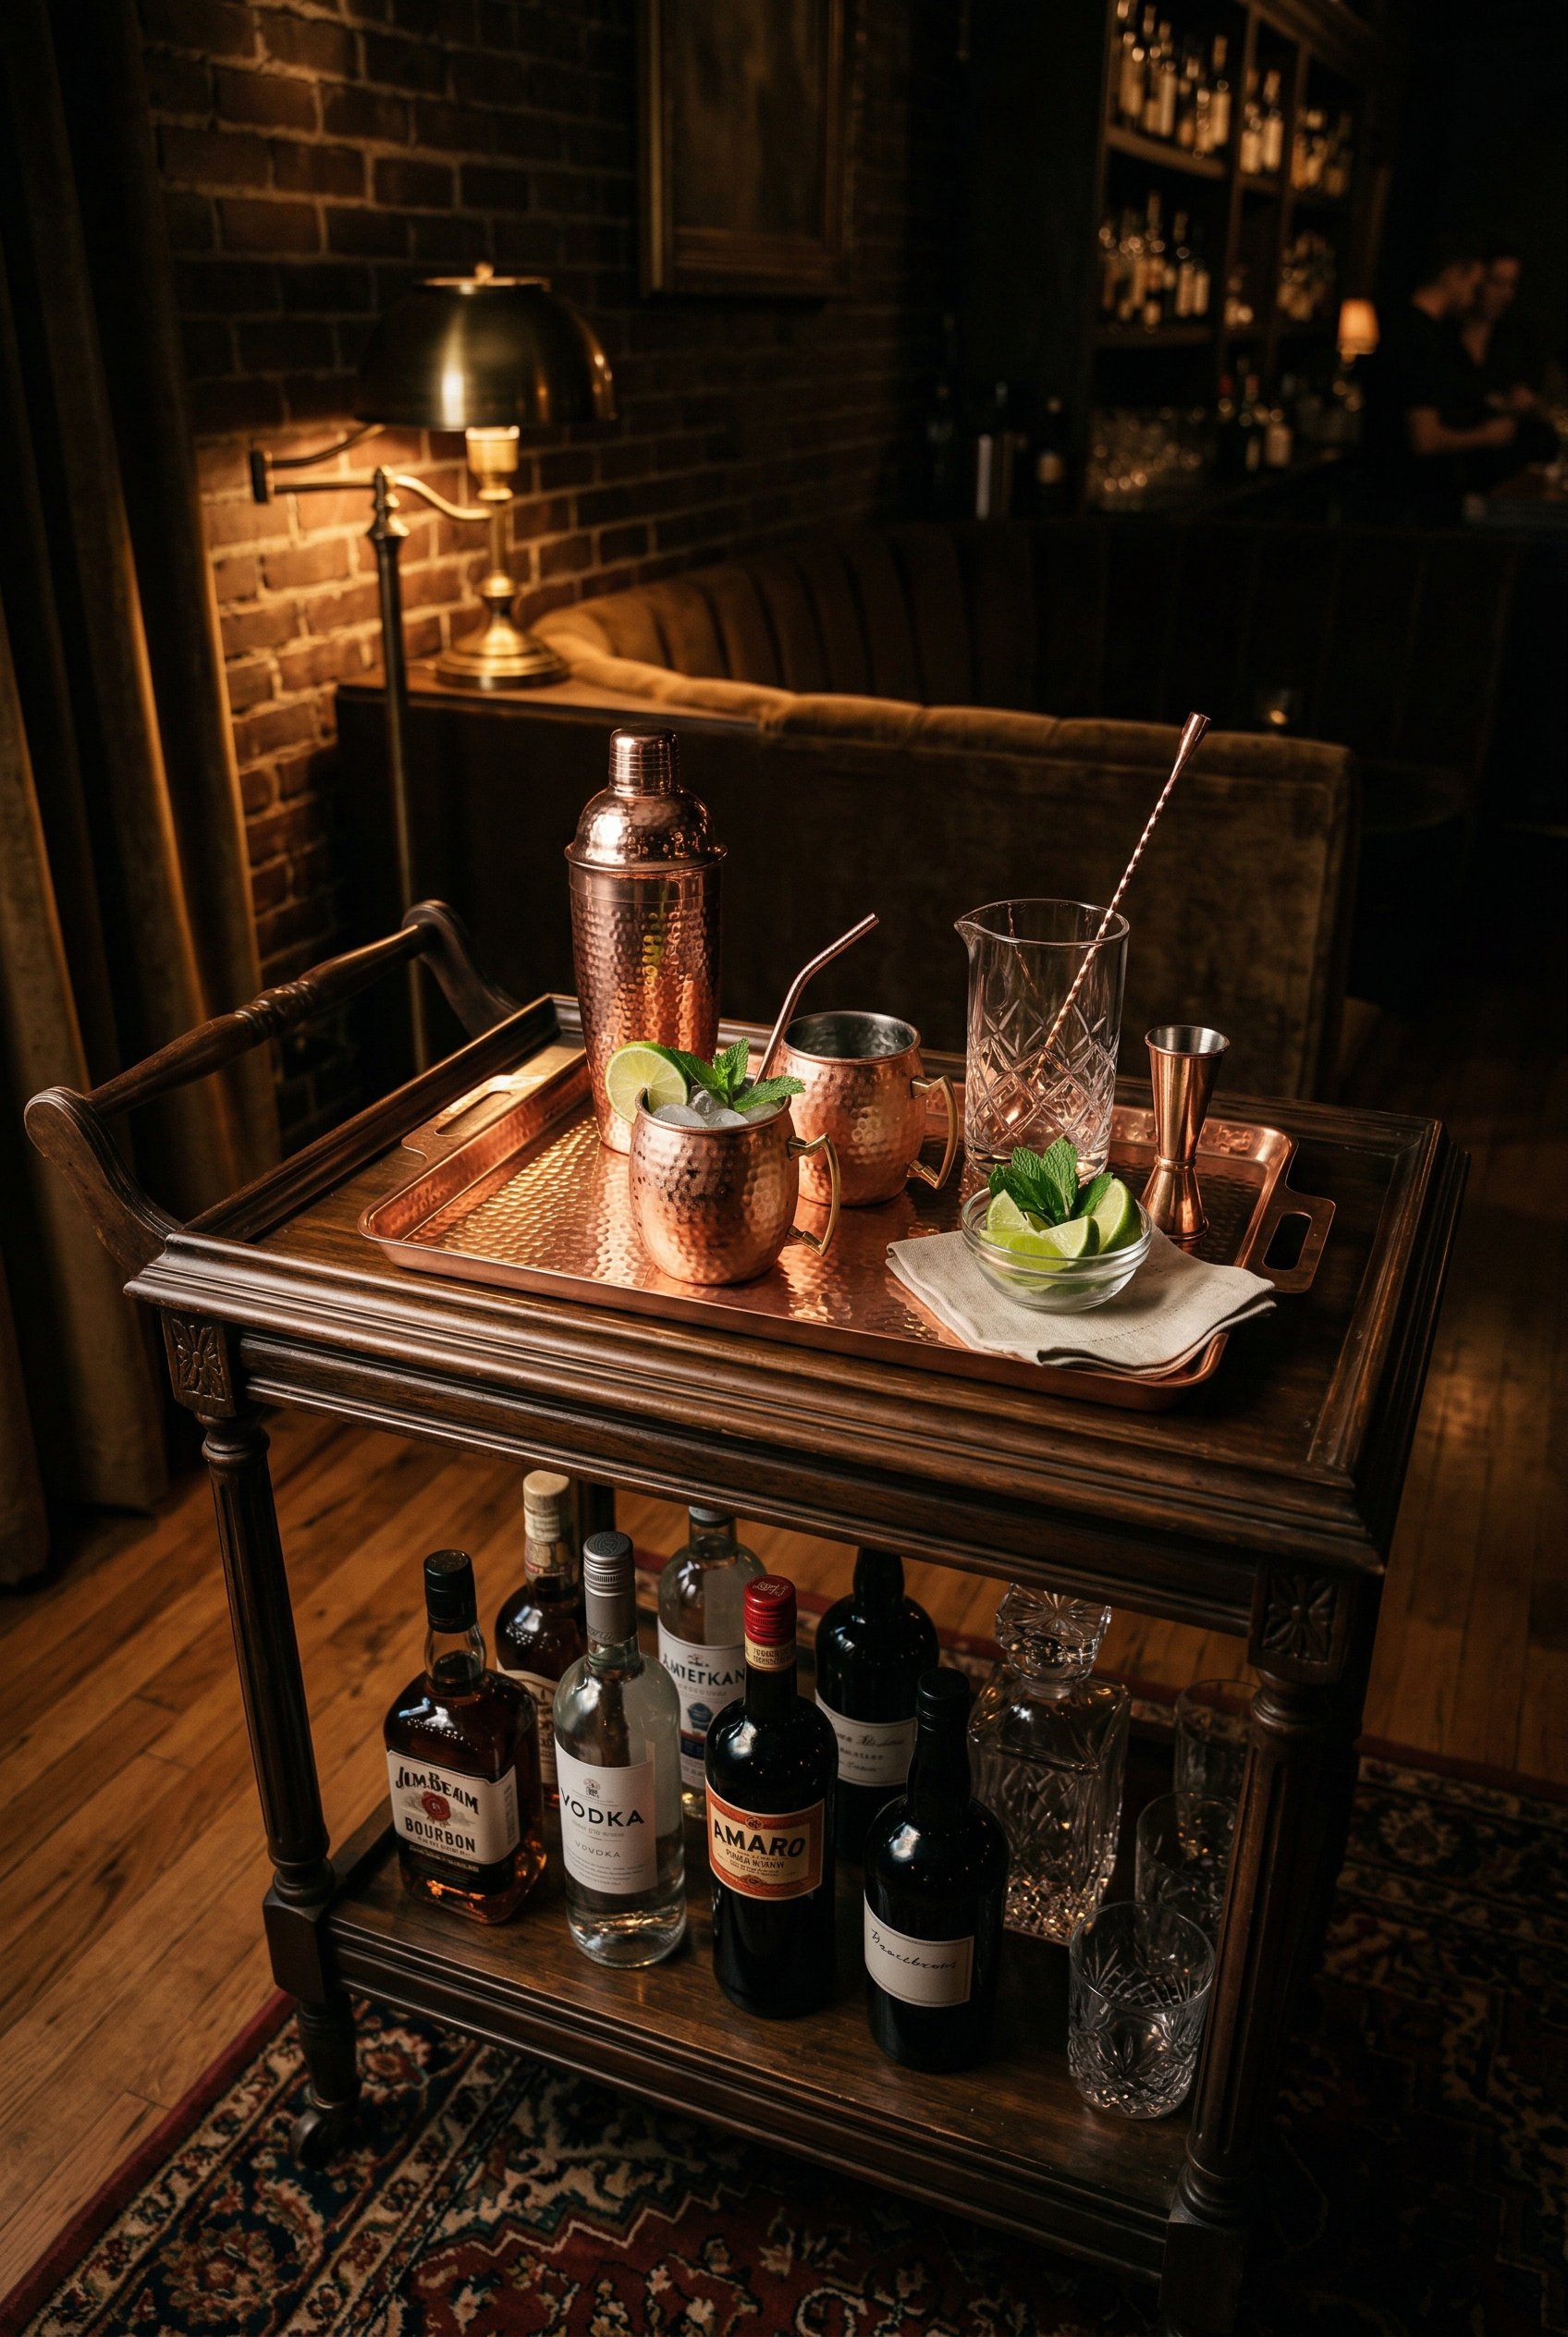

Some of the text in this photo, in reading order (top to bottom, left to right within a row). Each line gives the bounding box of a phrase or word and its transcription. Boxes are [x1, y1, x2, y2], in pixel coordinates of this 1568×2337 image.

[560, 1787, 644, 1828] VODKA
[404, 1817, 476, 1854] BOURBON
[714, 1818, 806, 1858] AMARO
